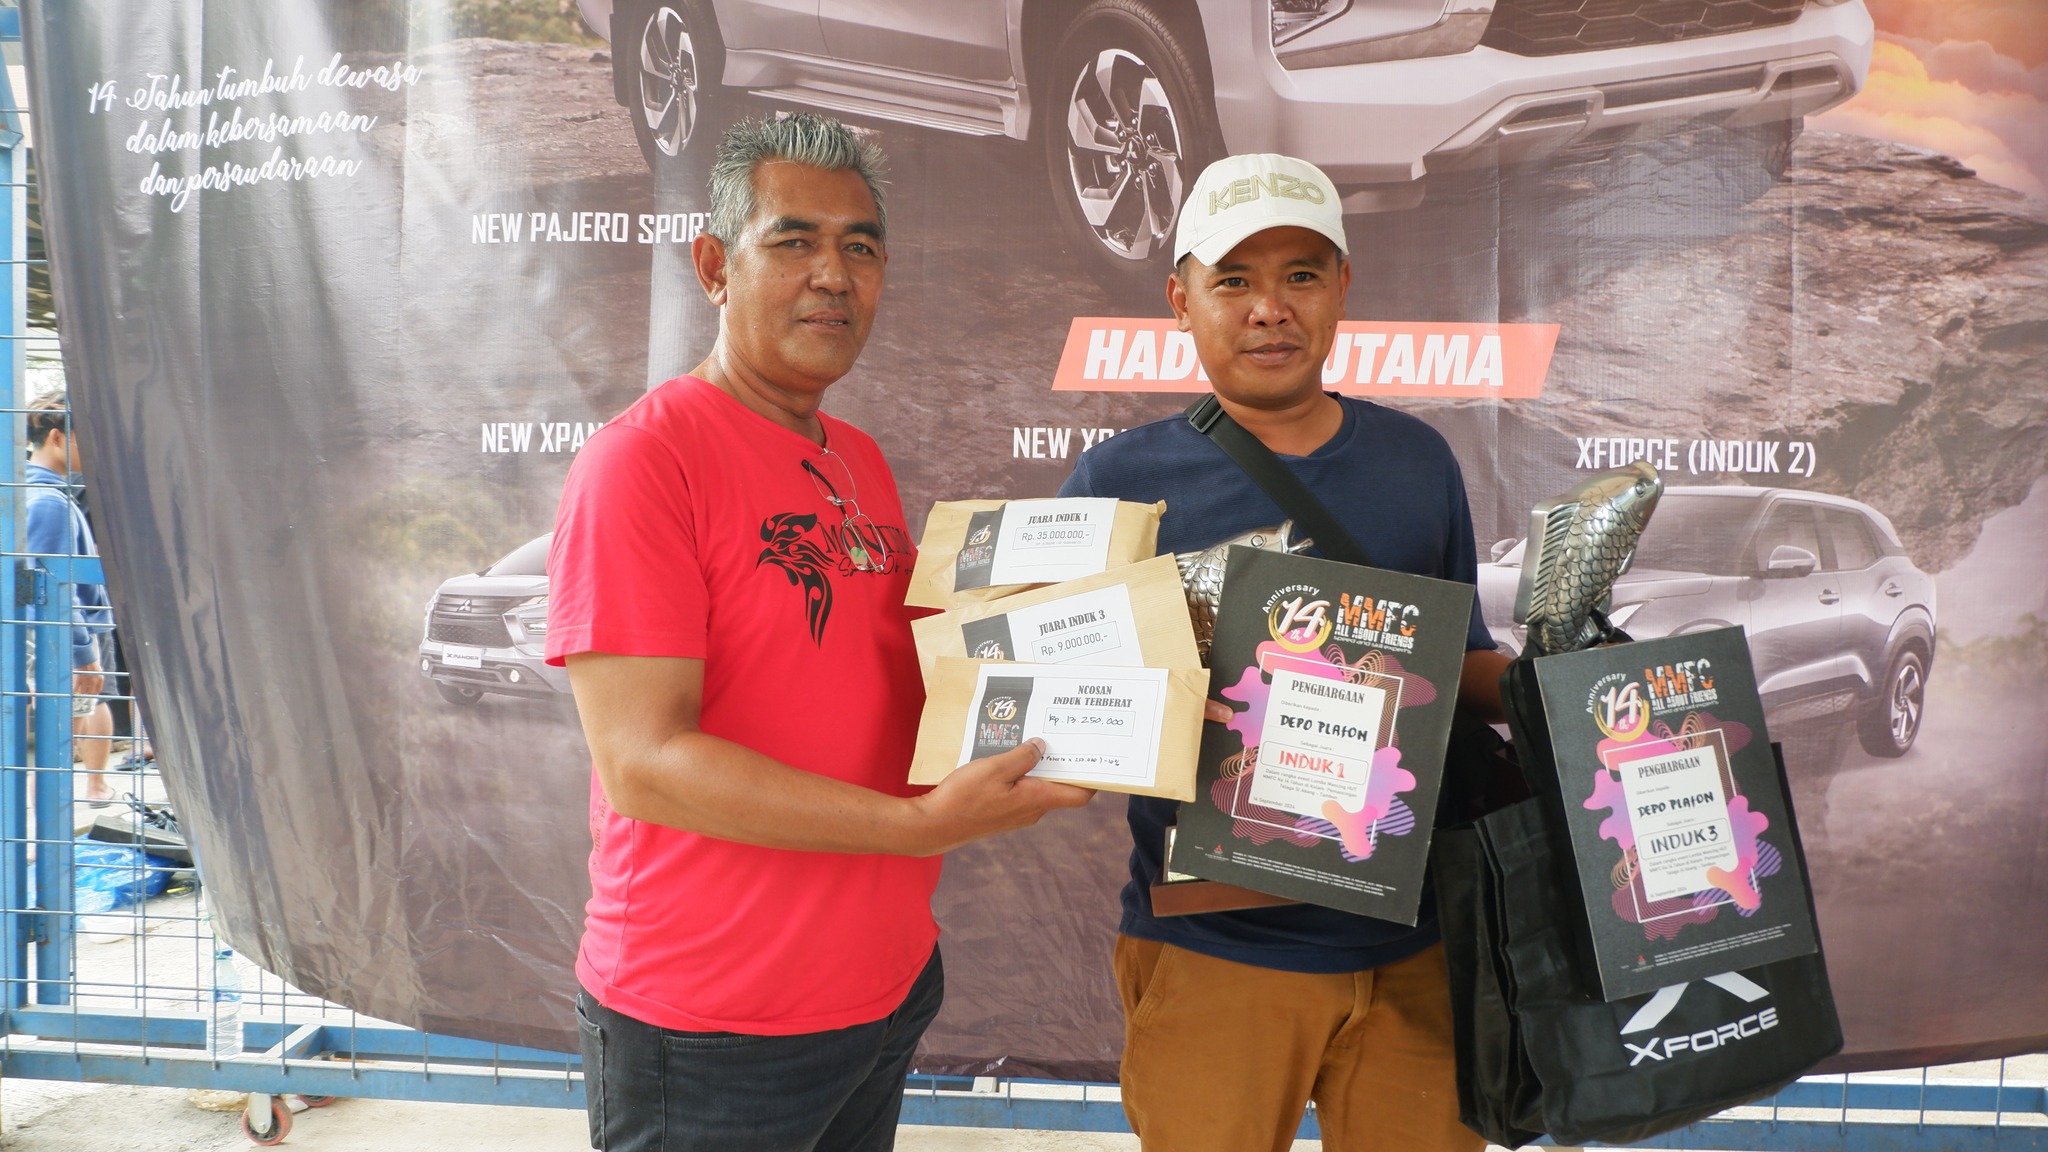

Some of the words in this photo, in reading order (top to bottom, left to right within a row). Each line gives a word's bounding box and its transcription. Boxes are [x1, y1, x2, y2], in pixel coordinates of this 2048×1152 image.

[88, 80, 117, 113] 14
[213, 55, 311, 101] tumbuh
[317, 52, 423, 91] dewasa
[126, 118, 203, 155] dalam
[205, 106, 377, 149] kebersamaan
[140, 163, 184, 197] dan
[170, 146, 362, 213] persaudaraan
[1209, 172, 1325, 216] KENZO
[472, 213, 523, 244] NEW
[531, 212, 628, 243] PAJERO
[1083, 329, 1210, 381] HAD
[482, 423, 532, 452] NEW
[1013, 427, 1071, 459] NEW
[1575, 437, 1679, 471] XFORCE
[1688, 439, 1780, 475] (INDUK
[1787, 441, 1817, 478] 2)
[1028, 513, 1053, 525] JUARA
[1055, 512, 1081, 523] INDUK
[1083, 512, 1088, 522] 1
[1021, 532, 1034, 542] Rp.
[1037, 530, 1089, 540] 35.000.000,-
[1262, 584, 1320, 614] Anniversary
[1039, 619, 1066, 636] JUARA
[1069, 612, 1097, 628] INDUK
[1098, 610, 1106, 620] 3
[1278, 596, 1331, 638] 14
[1335, 592, 1420, 637] MMFC
[1041, 645, 1056, 656] Rp.
[1057, 632, 1108, 651] 9.000.000,-
[1334, 624, 1349, 637] ALL
[1351, 627, 1378, 642] ABOUT
[1380, 631, 1414, 650] FRIENDS
[1078, 685, 1112, 695] NCOSAN
[1291, 679, 1365, 704] PENGHARGAAN
[1644, 658, 1714, 699] MMFC
[1053, 697, 1081, 705] INDUK
[1085, 697, 1132, 707] TERBERAT
[1586, 673, 1627, 714] Anniversary
[1600, 681, 1643, 729] 14
[1652, 698, 1665, 711] ALL
[1667, 693, 1688, 708] ABOUT
[1689, 688, 1718, 704] FRIENDS
[1280, 714, 1313, 731] DEPO
[1279, 750, 1333, 774] INDUK
[1337, 763, 1345, 778] 1
[1637, 755, 1701, 778] PENGHARGAAN
[1637, 802, 1666, 818] DEPO
[1650, 828, 1707, 854] INDUK
[1707, 825, 1718, 841] 3
[1624, 1007, 1780, 1067] XFORCE
